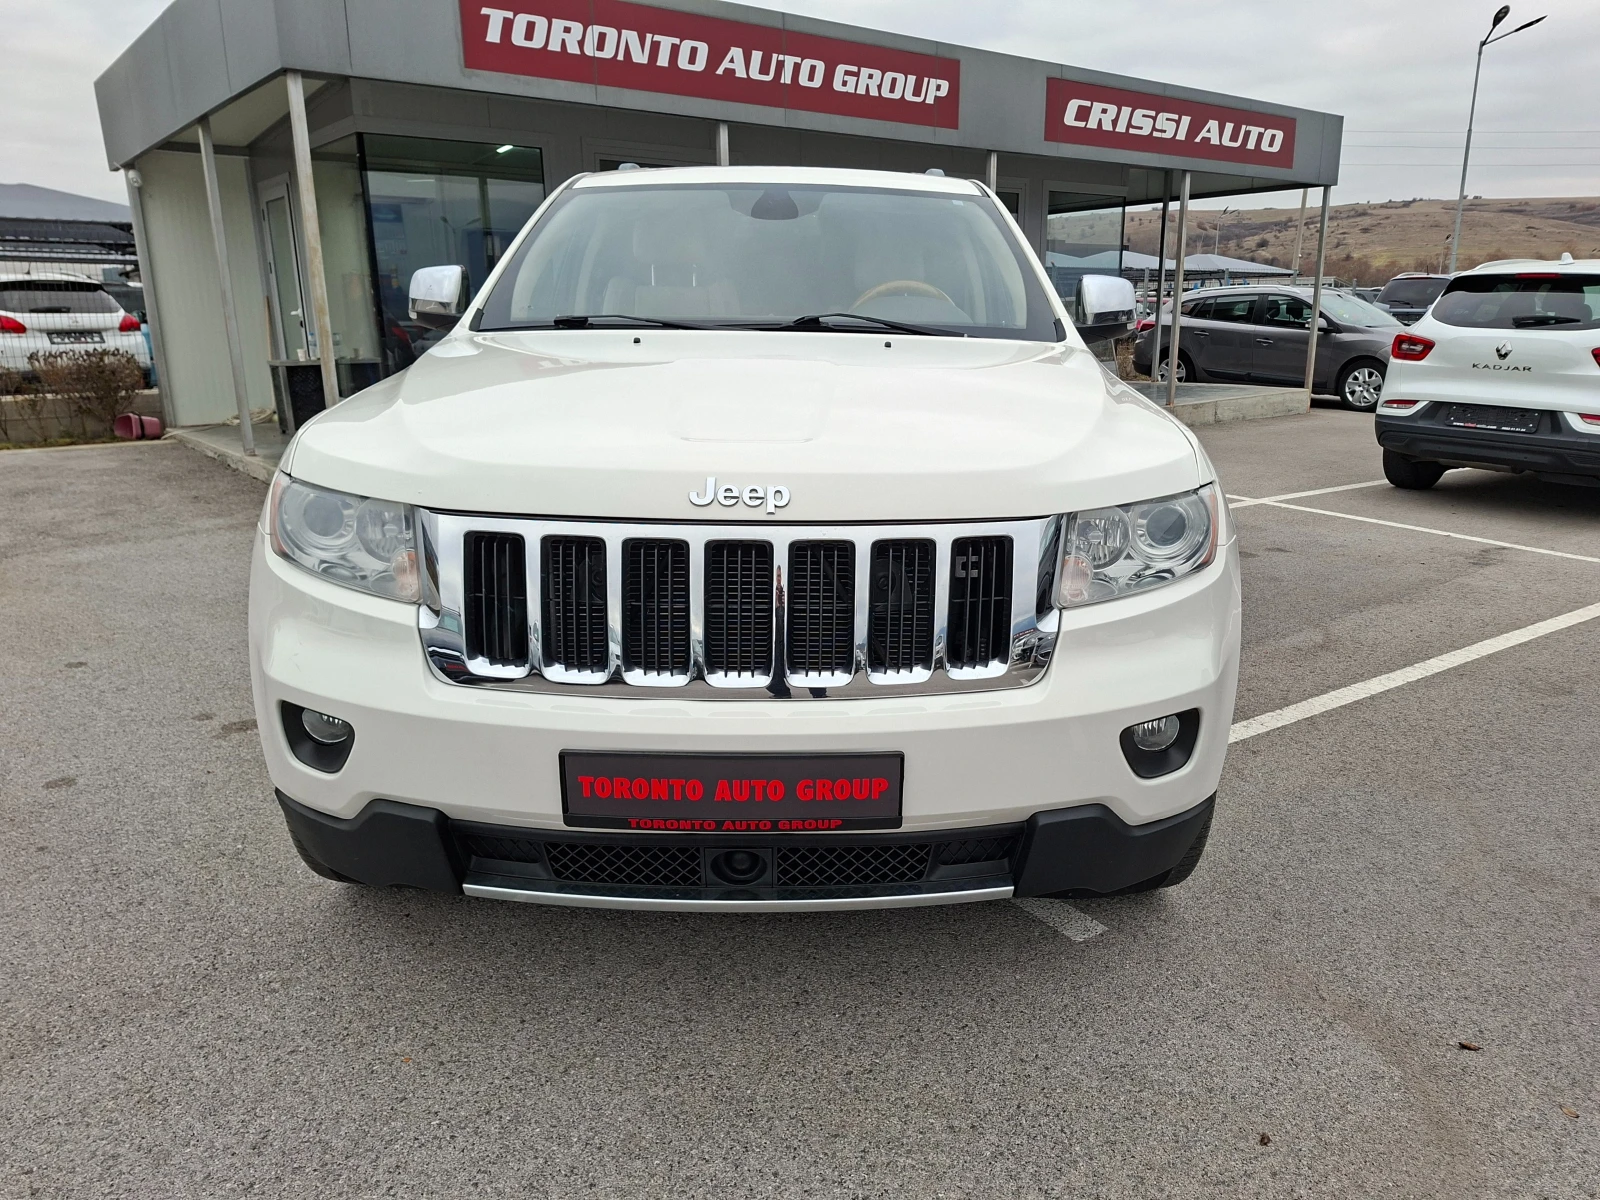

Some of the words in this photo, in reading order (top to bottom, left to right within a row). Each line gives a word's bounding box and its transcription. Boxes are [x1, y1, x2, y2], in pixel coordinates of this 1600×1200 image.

[480, 7, 709, 72] TORONTO
[716, 45, 825, 89] AUTO
[833, 64, 949, 104] GROUP
[1063, 98, 1191, 140] CRISSI
[1194, 119, 1284, 153] AUTO
[1472, 363, 1532, 372] KADJAR
[688, 476, 791, 515] Jeep
[577, 776, 704, 801] TORONTO
[714, 779, 785, 801] AUTO
[796, 777, 889, 801] GROUP
[628, 818, 716, 830] TORONTO
[722, 820, 772, 830] AUTO
[778, 819, 842, 830] GROUP
